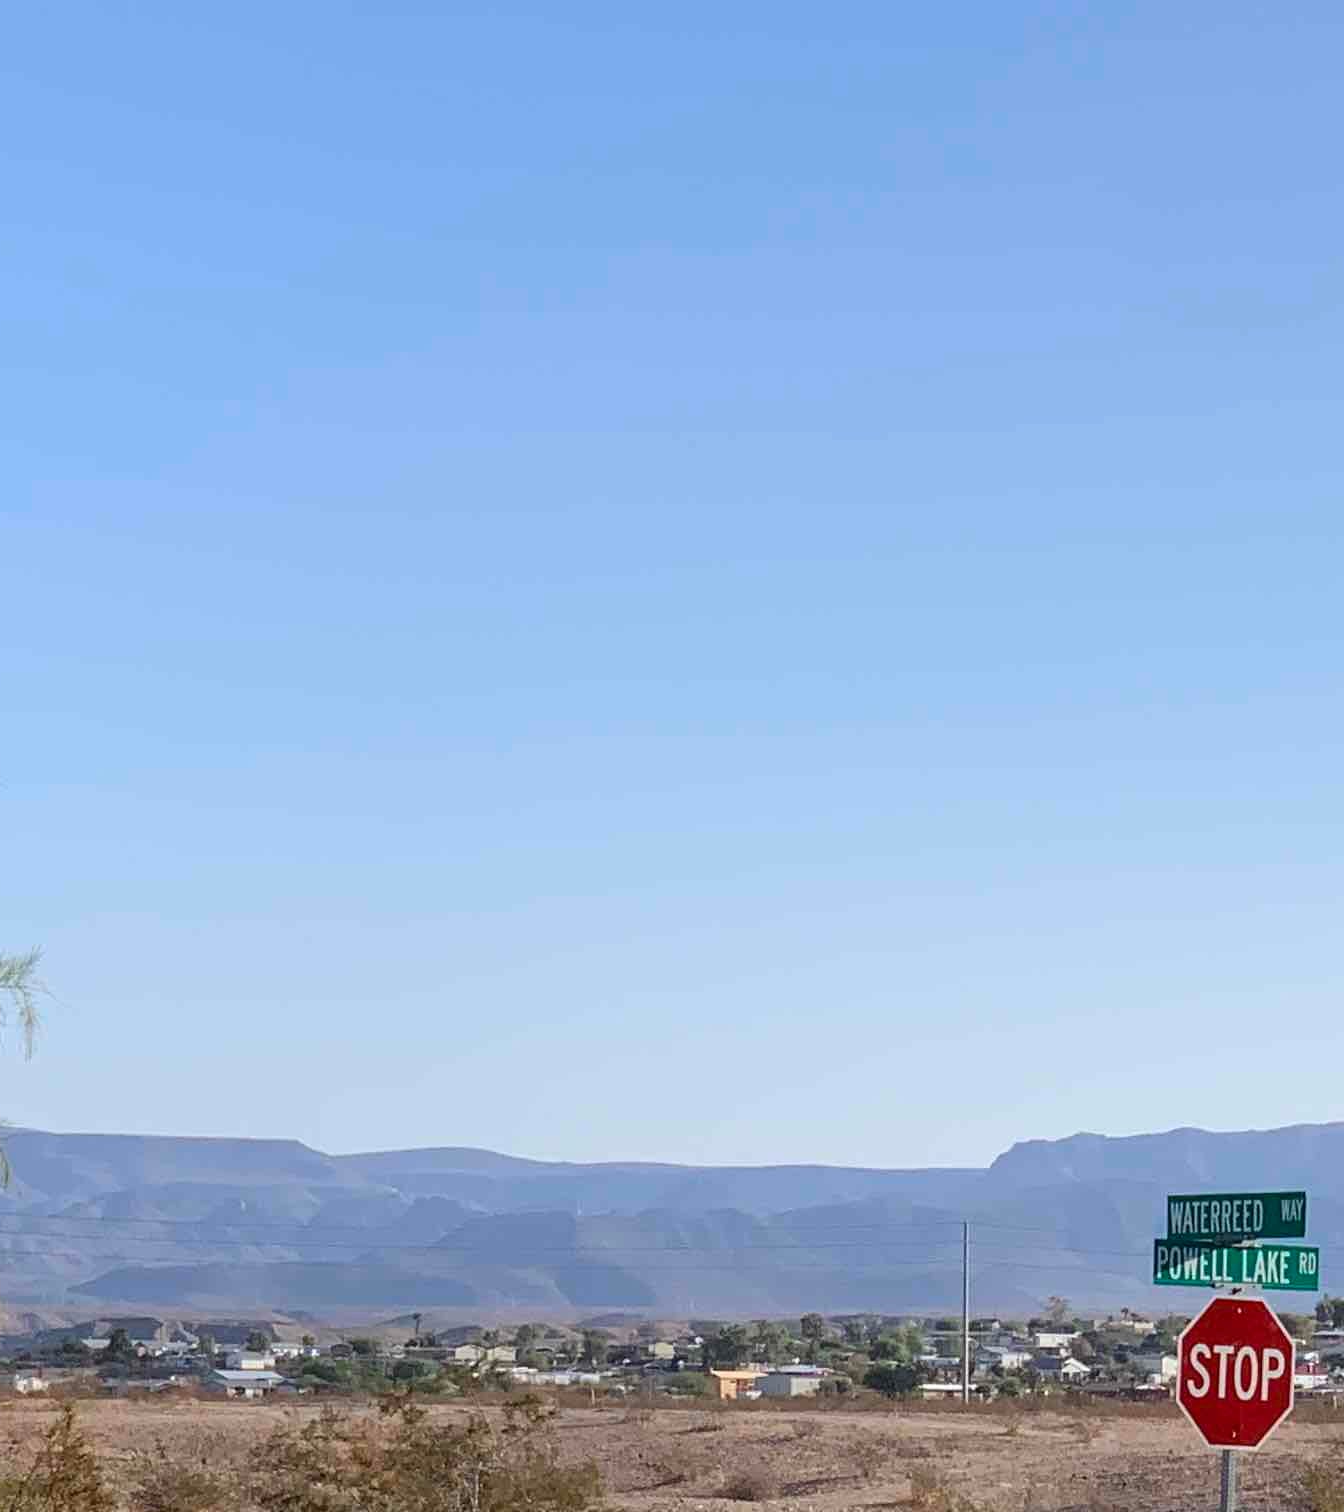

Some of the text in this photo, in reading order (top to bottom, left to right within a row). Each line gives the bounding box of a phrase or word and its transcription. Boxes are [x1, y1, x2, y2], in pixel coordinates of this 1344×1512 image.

[1170, 1199, 1304, 1234] WATERREED WAY
[1157, 1247, 1317, 1284] POWELL LAKE RD
[1186, 1343, 1286, 1402] STOP
